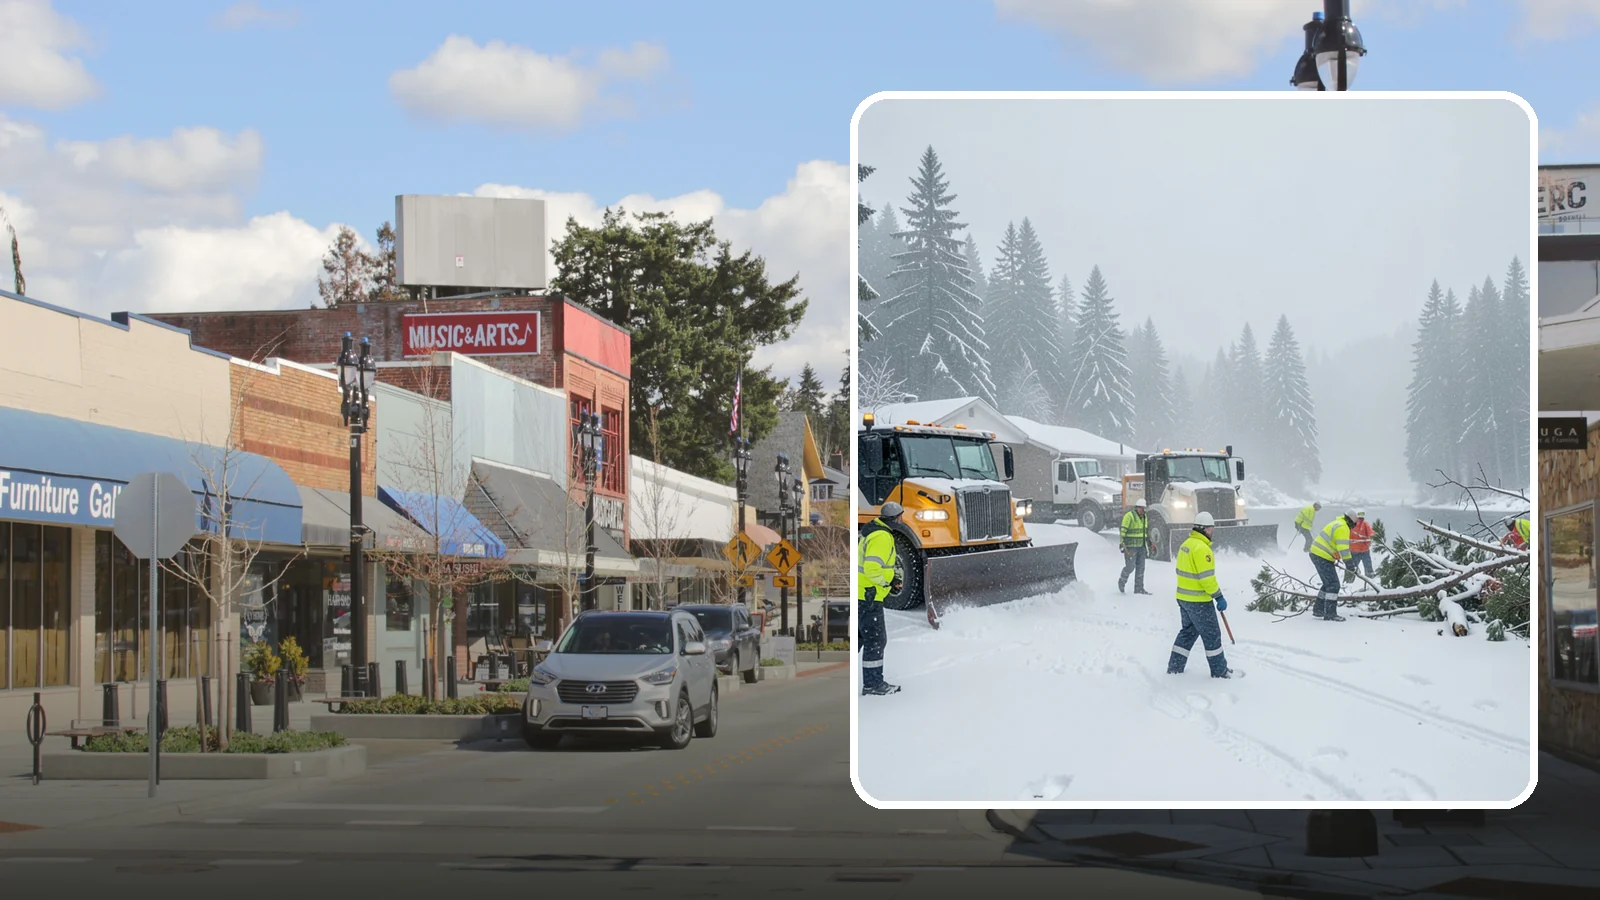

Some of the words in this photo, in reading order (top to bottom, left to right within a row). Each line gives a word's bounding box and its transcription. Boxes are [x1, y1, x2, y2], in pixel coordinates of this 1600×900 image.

[0, 471, 79, 516] Furniture
[89, 482, 121, 519] Gal
[453, 563, 480, 575] SUSHI
